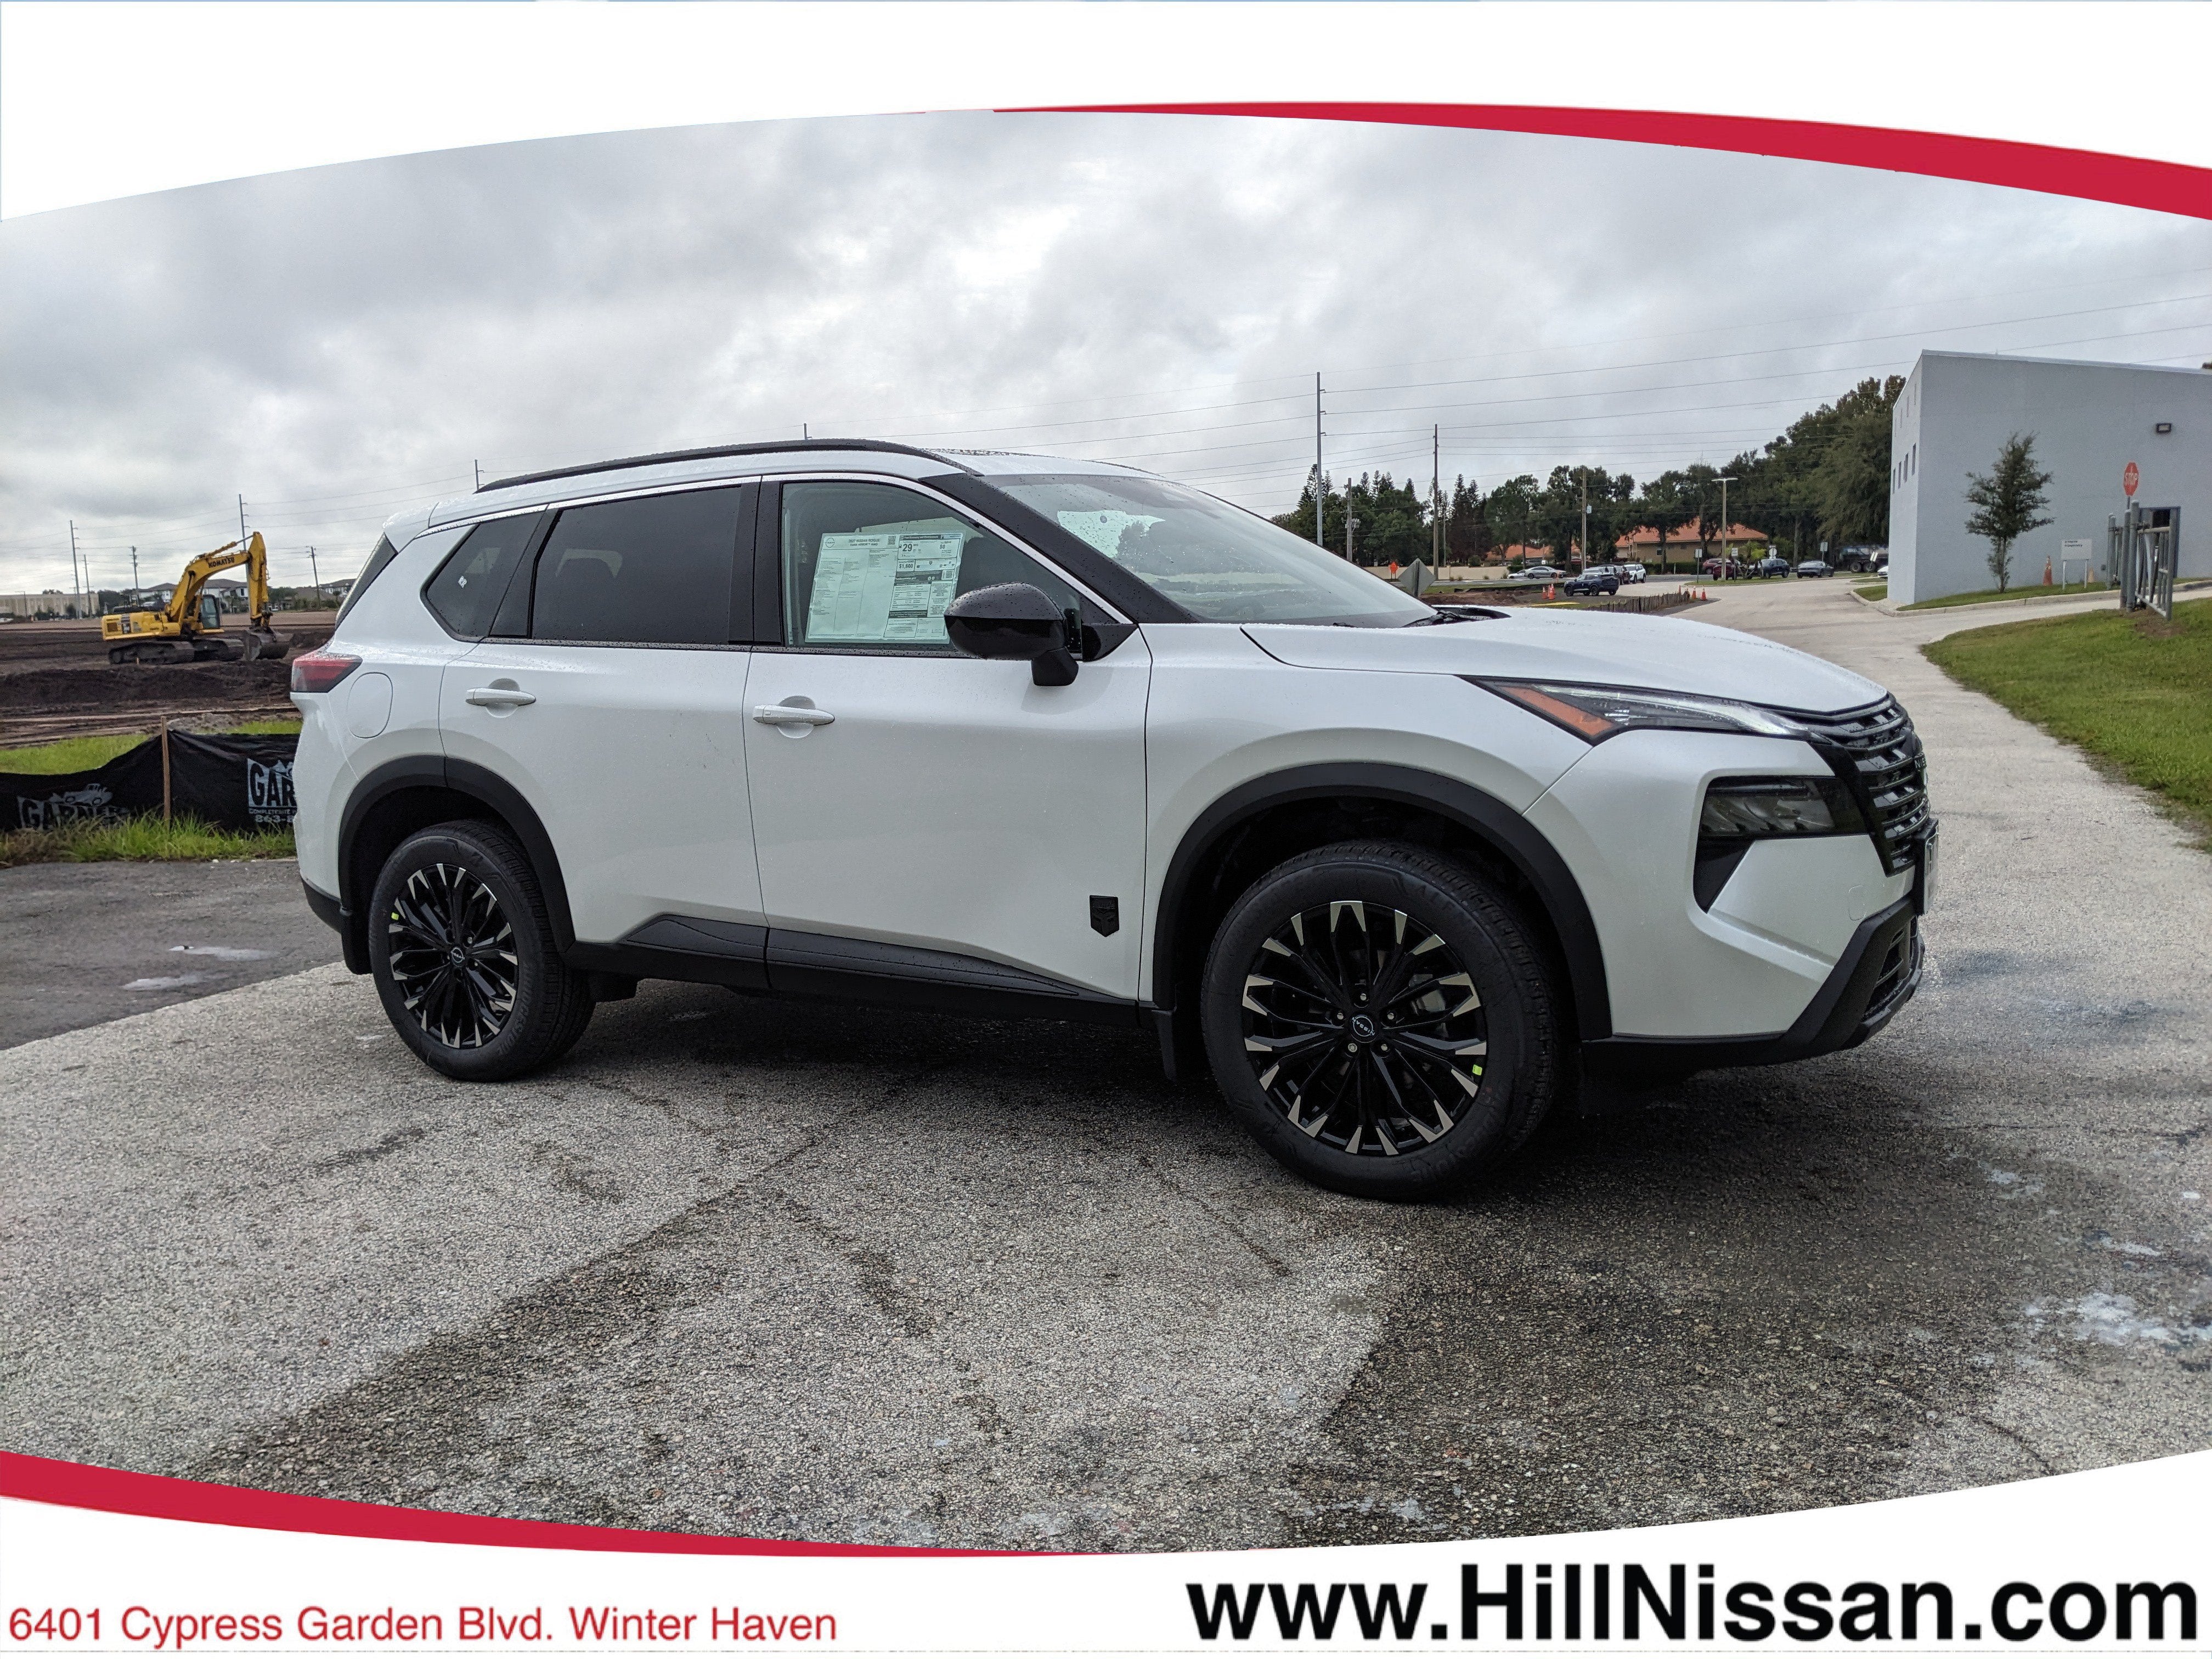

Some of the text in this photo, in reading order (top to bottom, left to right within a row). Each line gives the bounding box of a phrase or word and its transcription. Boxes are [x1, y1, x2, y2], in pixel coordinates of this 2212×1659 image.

[2124, 472, 2138, 486] STOP
[902, 543, 912, 552] 29
[208, 556, 235, 568] KOMATSU
[1351, 1017, 1375, 1036] NISSAN
